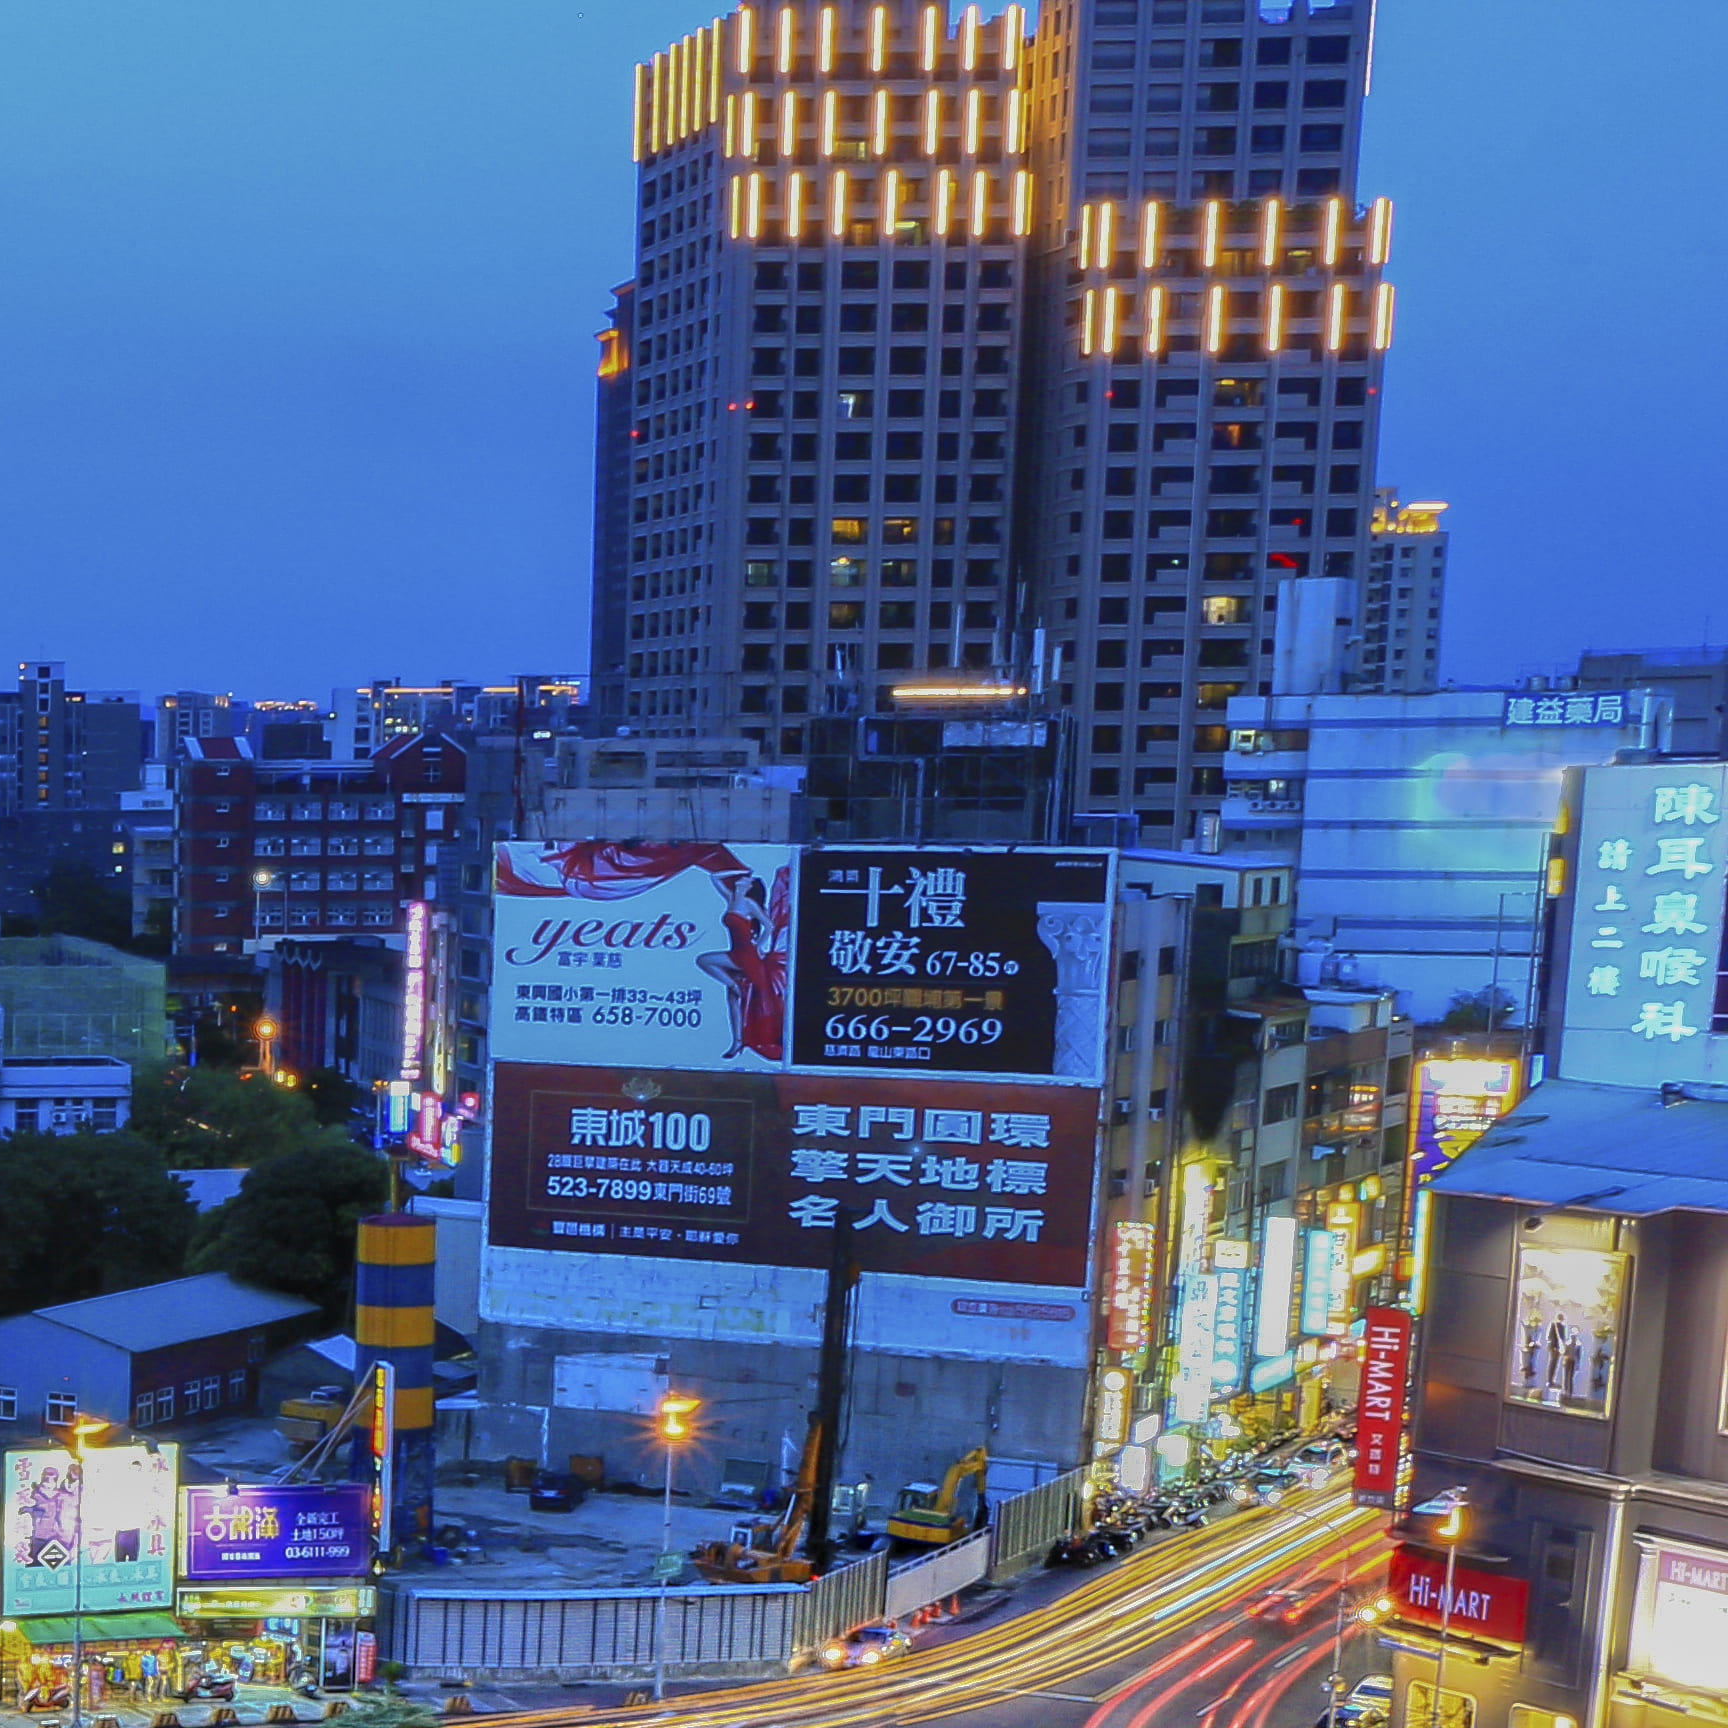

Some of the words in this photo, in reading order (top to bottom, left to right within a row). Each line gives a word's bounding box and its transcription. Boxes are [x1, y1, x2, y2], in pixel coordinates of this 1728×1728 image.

[1506, 695, 1624, 726] 建益藥局
[820, 867, 966, 928] 十禮
[1631, 783, 1720, 1042] 陳耳鼻喉科
[505, 913, 706, 966] yeats
[829, 930, 921, 975] 敬安
[592, 1006, 702, 1028] 658-7000
[825, 1014, 1003, 1045] 666-2969
[570, 1107, 711, 1152] 東城100
[792, 1104, 1051, 1148] 東門圓環
[547, 1176, 653, 1200] 523-7899
[790, 1148, 1049, 1195] 擎天地標
[788, 1195, 1045, 1243] 名人御所
[1364, 1326, 1401, 1421] Hi-MART
